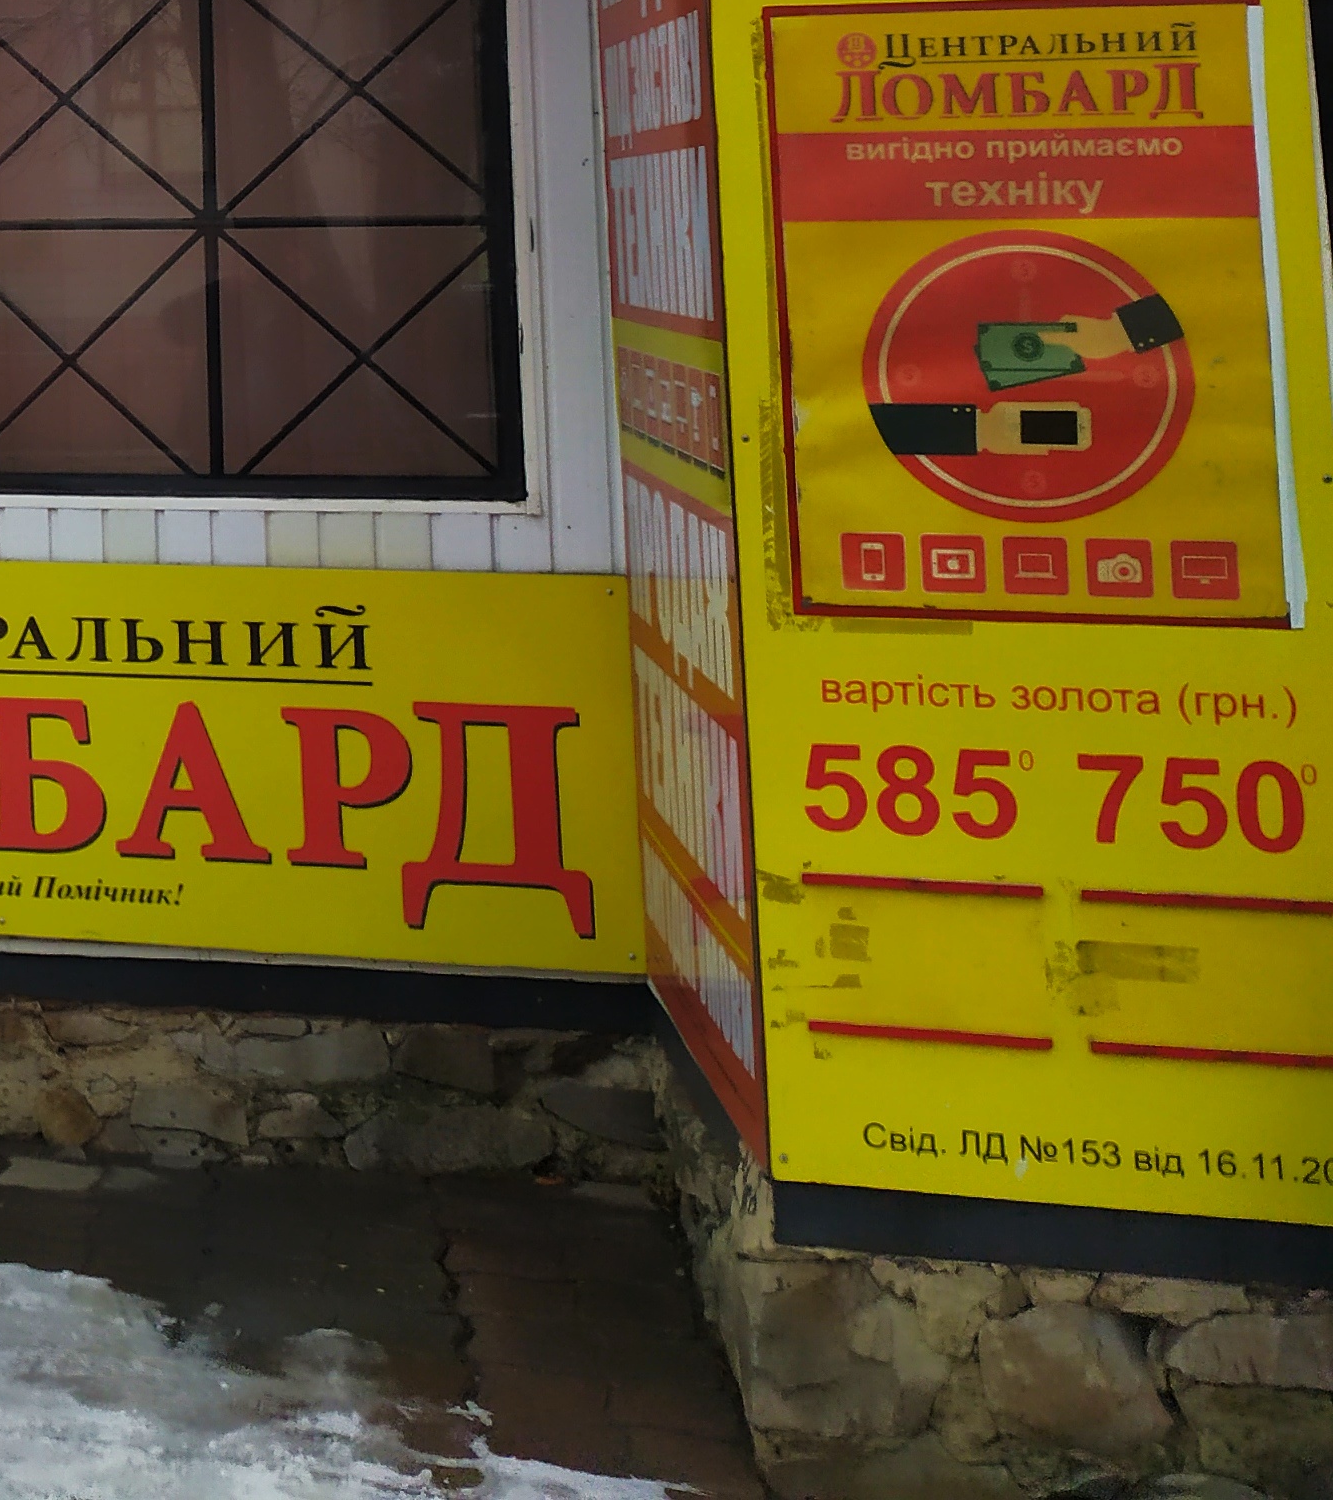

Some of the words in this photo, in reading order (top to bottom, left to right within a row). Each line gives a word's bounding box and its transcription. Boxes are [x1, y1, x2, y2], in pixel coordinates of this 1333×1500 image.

[879, 21, 1199, 70] ЦЕНТРАЛЬНИЙ
[829, 62, 1204, 123] ЛОМБАРД
[845, 136, 975, 164] вигідно
[986, 131, 1184, 164] приймаємо
[926, 173, 1104, 214] техніку
[820, 675, 997, 712] вартість
[1011, 682, 1161, 715] золота
[1178, 681, 1298, 728] (грн.)
[33, 874, 185, 906] Помічник!
[863, 1122, 946, 1156] Свід.
[959, 1129, 1009, 1164] ЛД
[1020, 1134, 1122, 1167] №153
[1134, 1150, 1185, 1180] від
